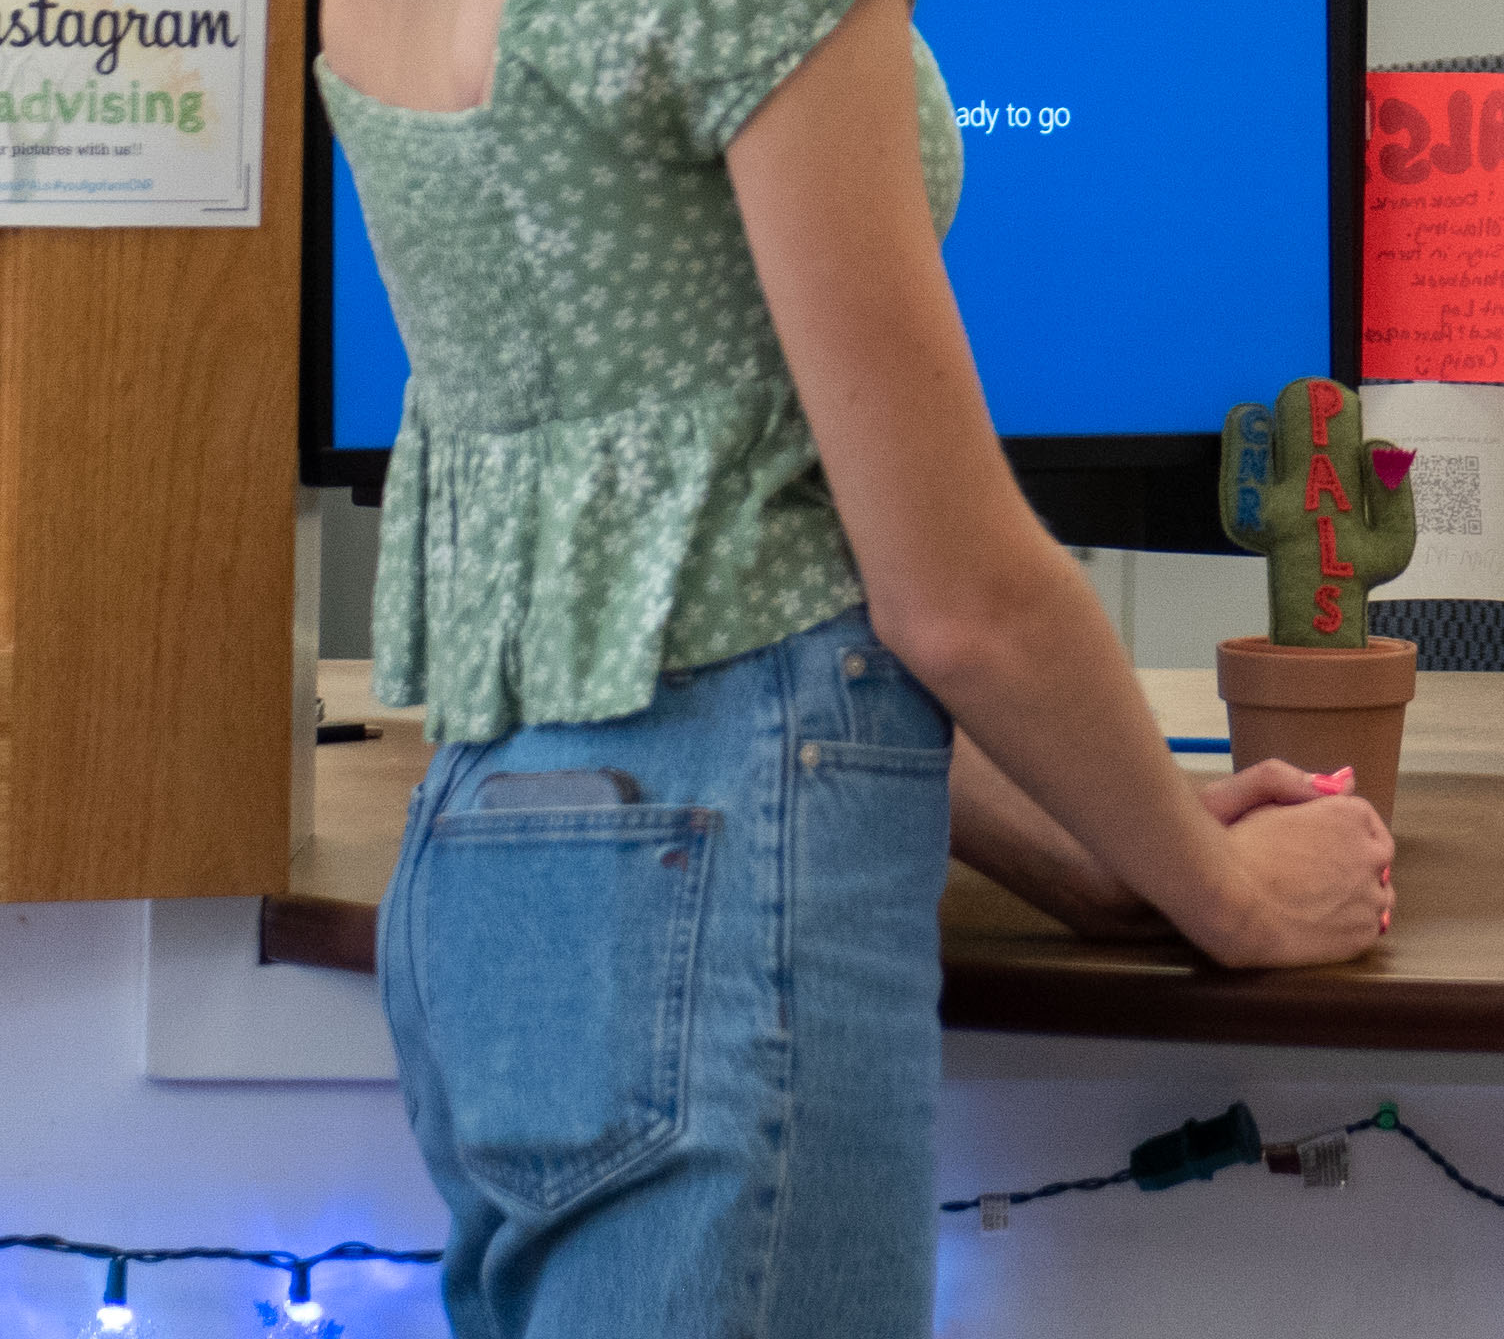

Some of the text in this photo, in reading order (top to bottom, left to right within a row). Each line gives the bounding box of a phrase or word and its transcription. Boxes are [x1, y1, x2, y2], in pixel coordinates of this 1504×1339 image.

[956, 100, 1070, 134] ady to go
[11, 142, 72, 156] pictures
[78, 143, 109, 156] with
[1305, 381, 1354, 634] PALS
